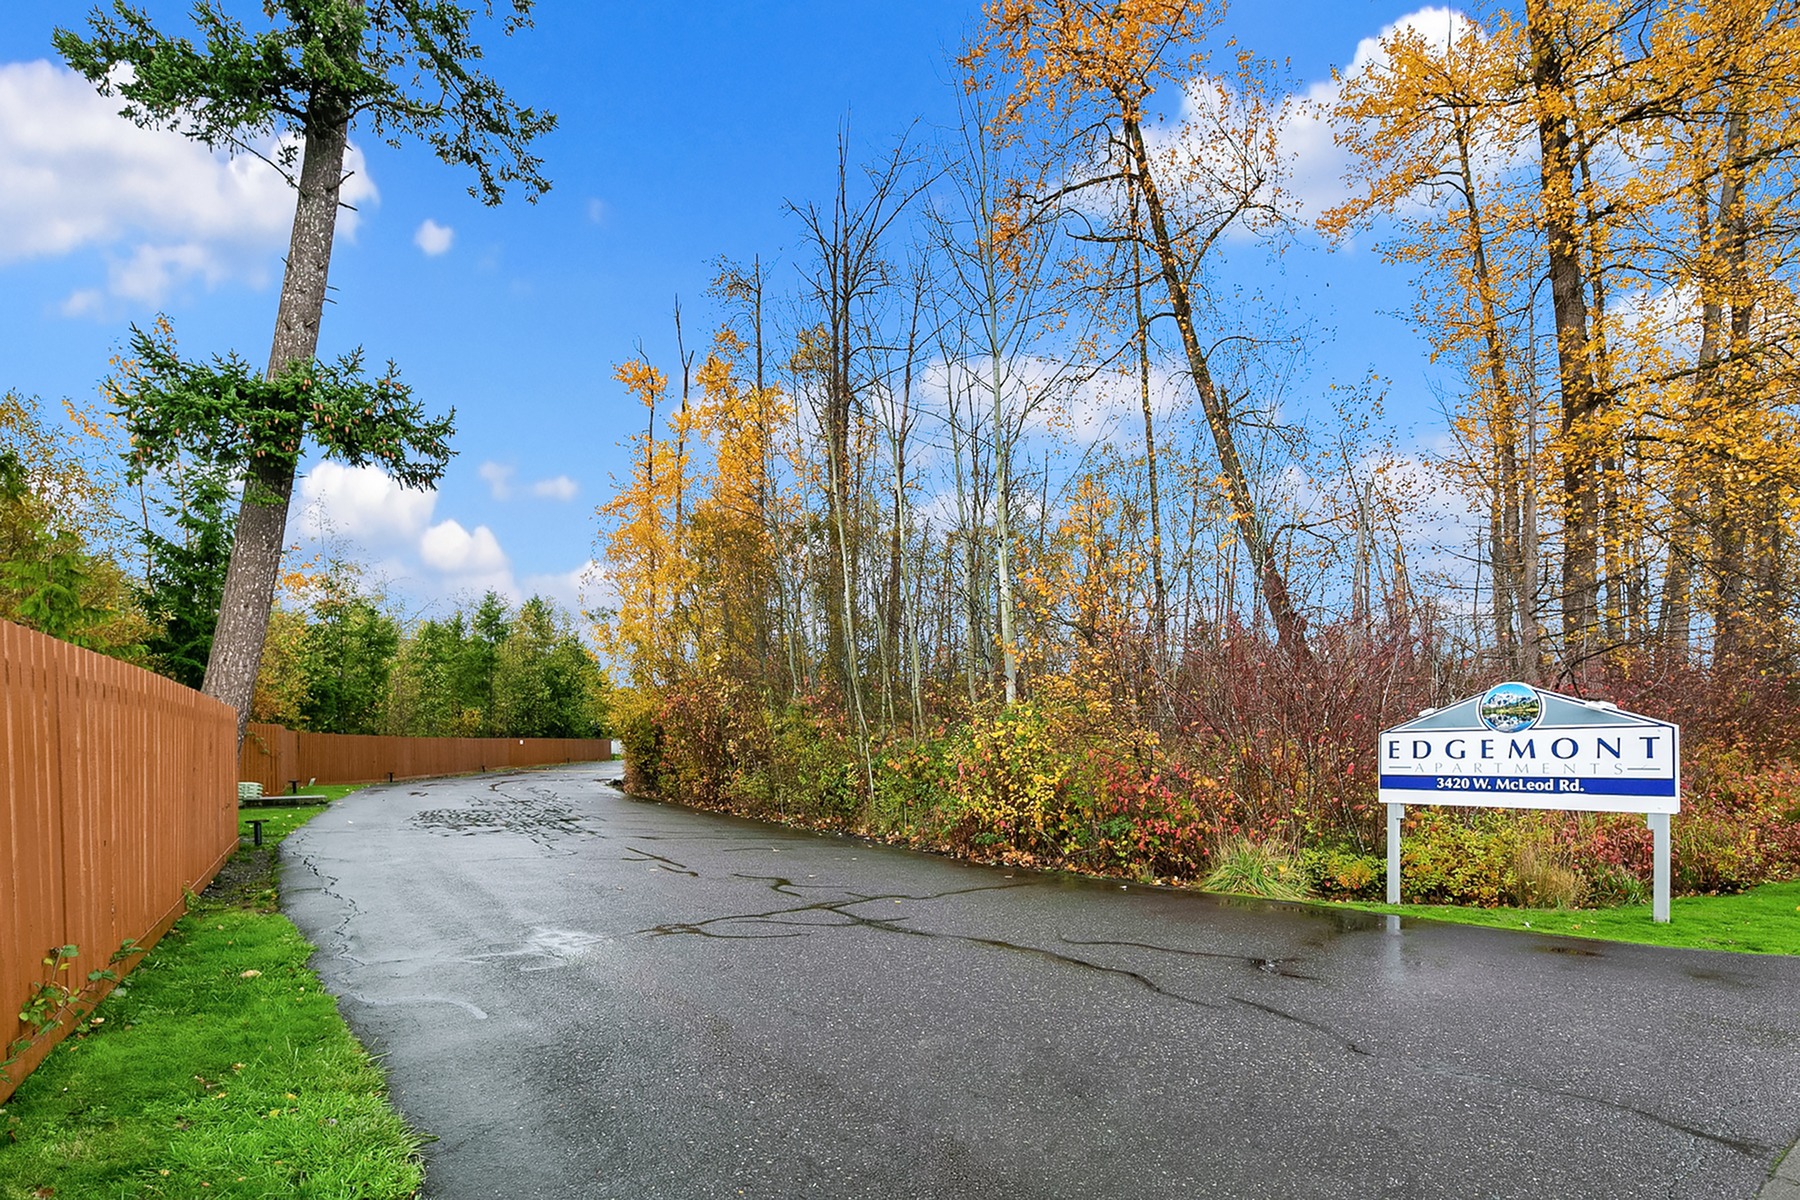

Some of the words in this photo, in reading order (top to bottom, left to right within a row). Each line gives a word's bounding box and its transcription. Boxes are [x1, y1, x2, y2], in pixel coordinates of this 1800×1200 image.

[1389, 737, 1660, 759] EDGEMONT
[1414, 762, 1623, 775] APARTMENTS
[1436, 777, 1470, 789] 3420
[1473, 778, 1492, 790] W.
[1495, 778, 1554, 791] McLeod
[1559, 779, 1585, 792] Rd.
